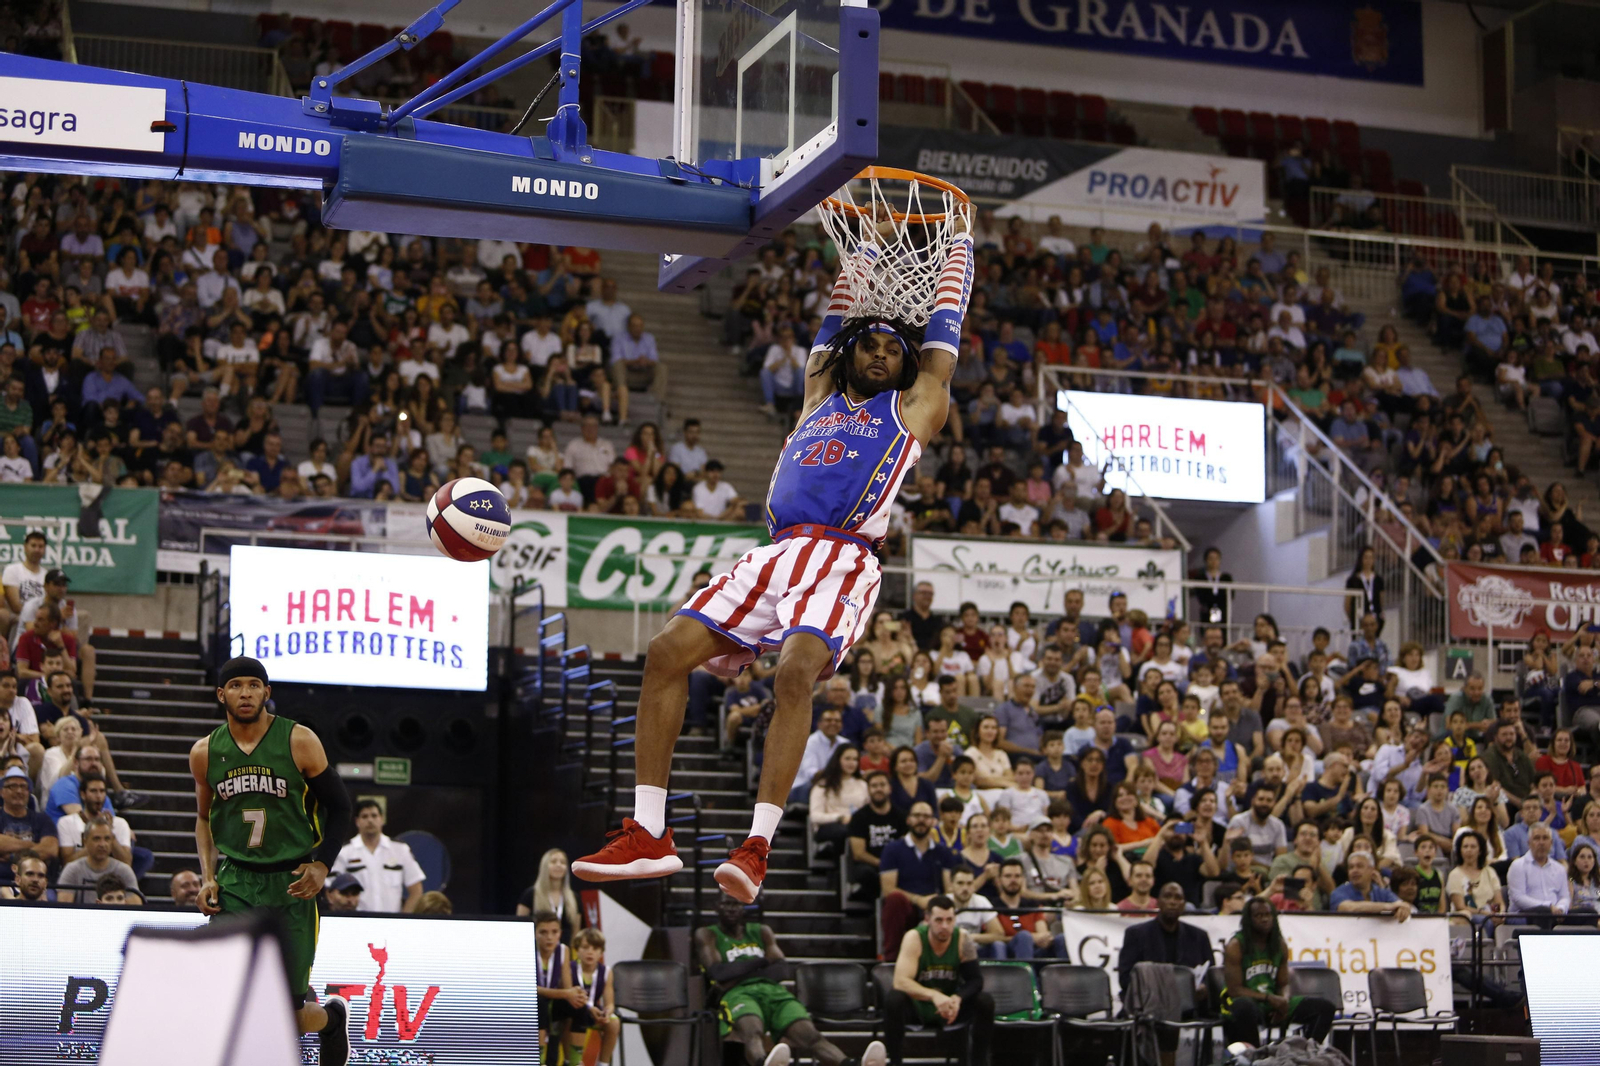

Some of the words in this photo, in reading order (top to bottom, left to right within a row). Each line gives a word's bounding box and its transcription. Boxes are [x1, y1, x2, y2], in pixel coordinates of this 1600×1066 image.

[913, 0, 996, 24] DE
[1017, 0, 1309, 58] GRANADA
[238, 131, 331, 156] MONDO
[916, 149, 1048, 182] BIENVENIDOS
[511, 175, 599, 200] MONDO
[1087, 168, 1240, 207] PROACTIV
[799, 438, 847, 467] 28
[1103, 424, 1206, 456] HARLEM
[496, 543, 562, 571] CSIF
[578, 526, 760, 603] CSIF
[286, 588, 434, 632] HARLEM
[255, 631, 463, 668] GLOBETROTTERS
[1452, 657, 1468, 678] A
[216, 774, 287, 800] GENERALS
[228, 766, 271, 779] WASHINGTON
[242, 807, 267, 849] 7
